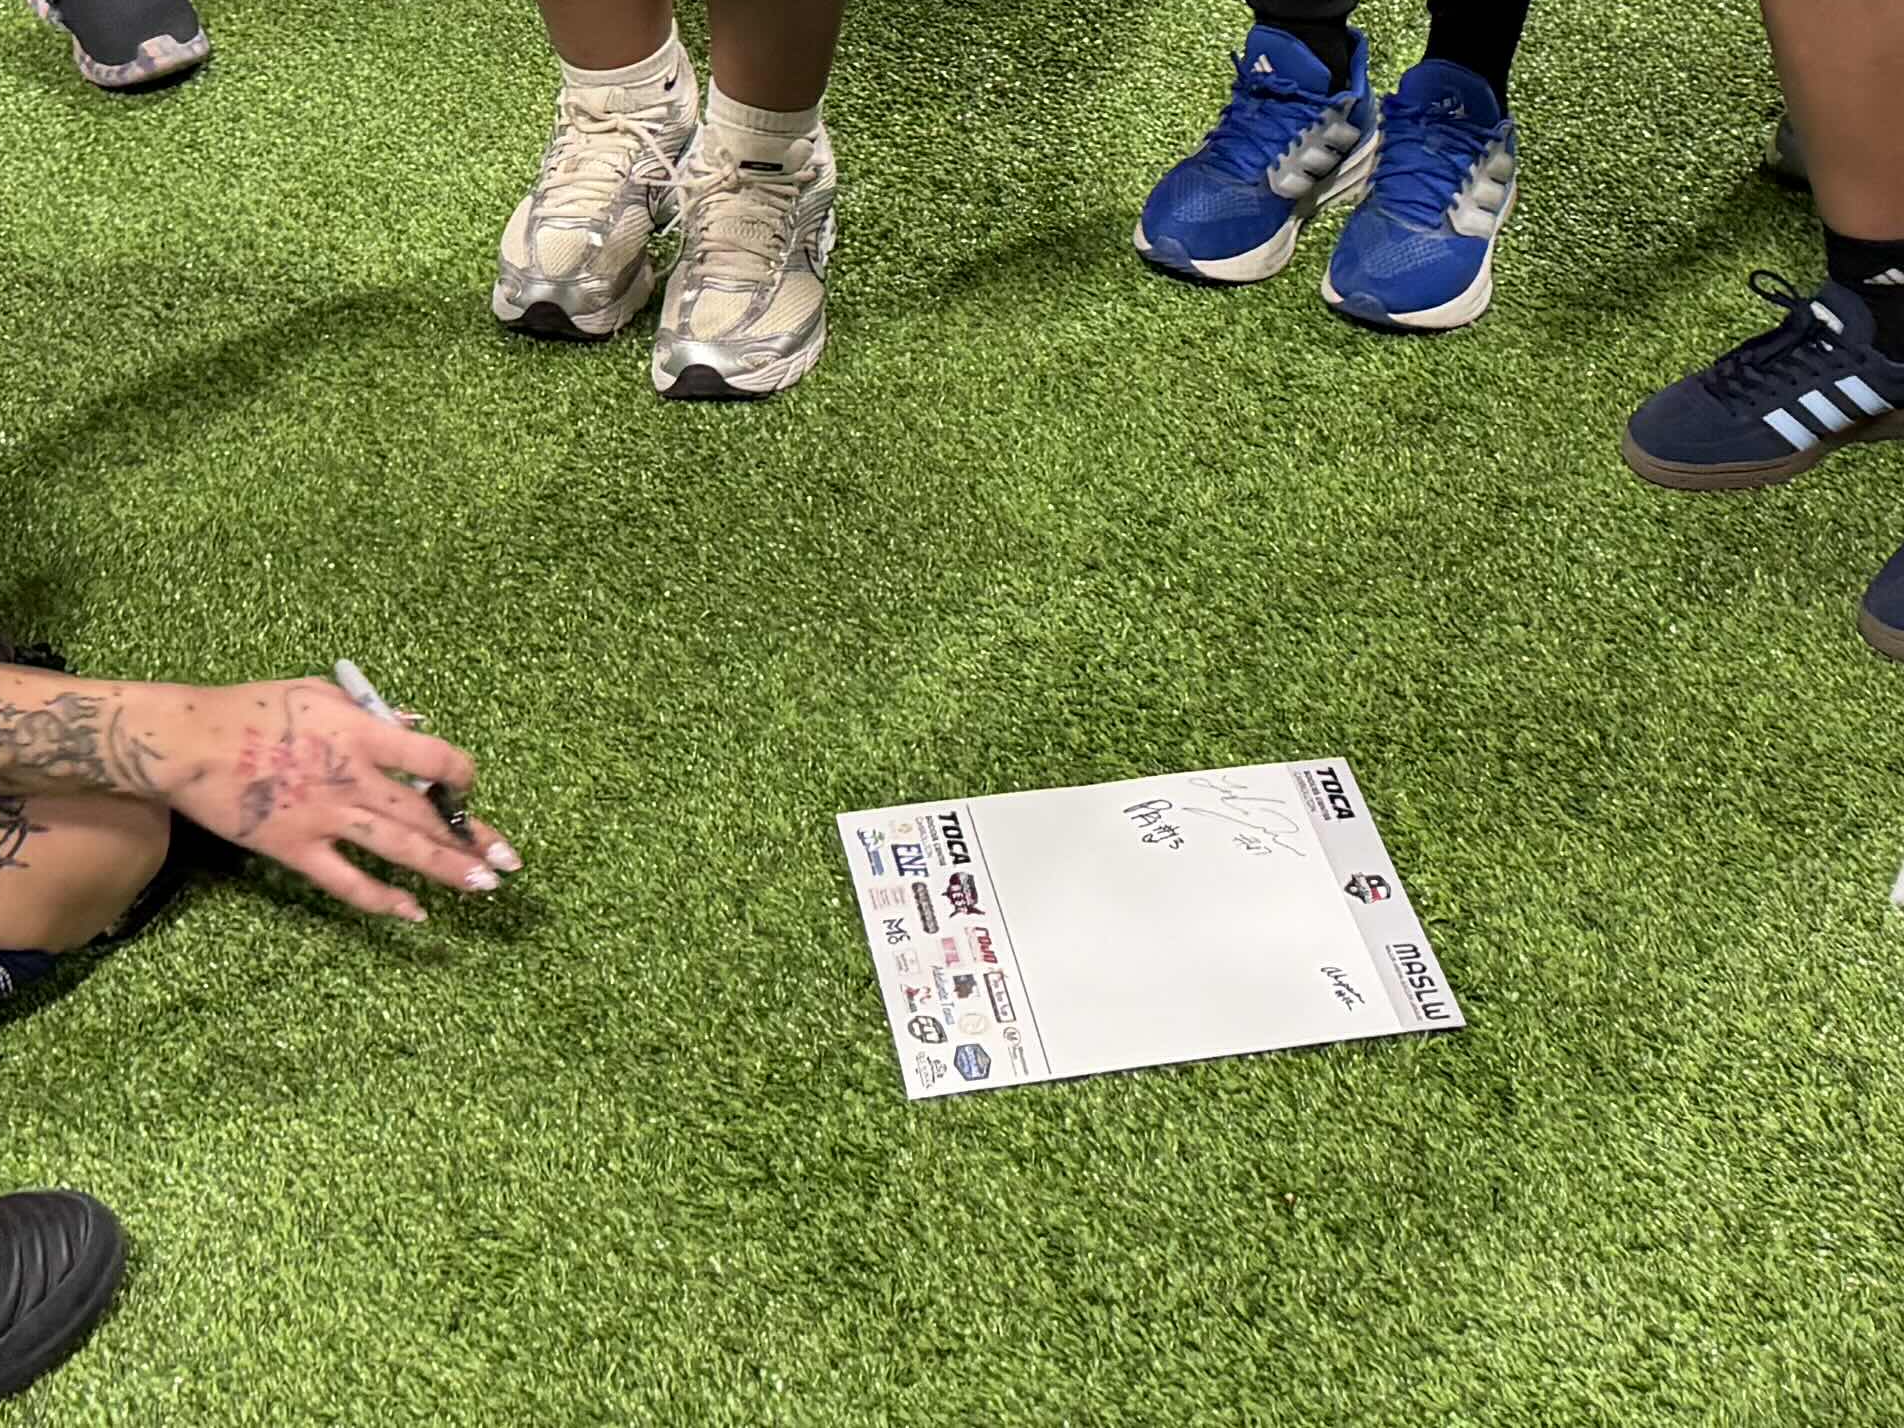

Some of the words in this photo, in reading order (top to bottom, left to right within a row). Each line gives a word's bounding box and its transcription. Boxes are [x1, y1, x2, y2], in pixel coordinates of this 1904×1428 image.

[1316, 766, 1356, 819] TOCA
[938, 811, 972, 865] TOCA
[1392, 943, 1451, 1021] MASLW
